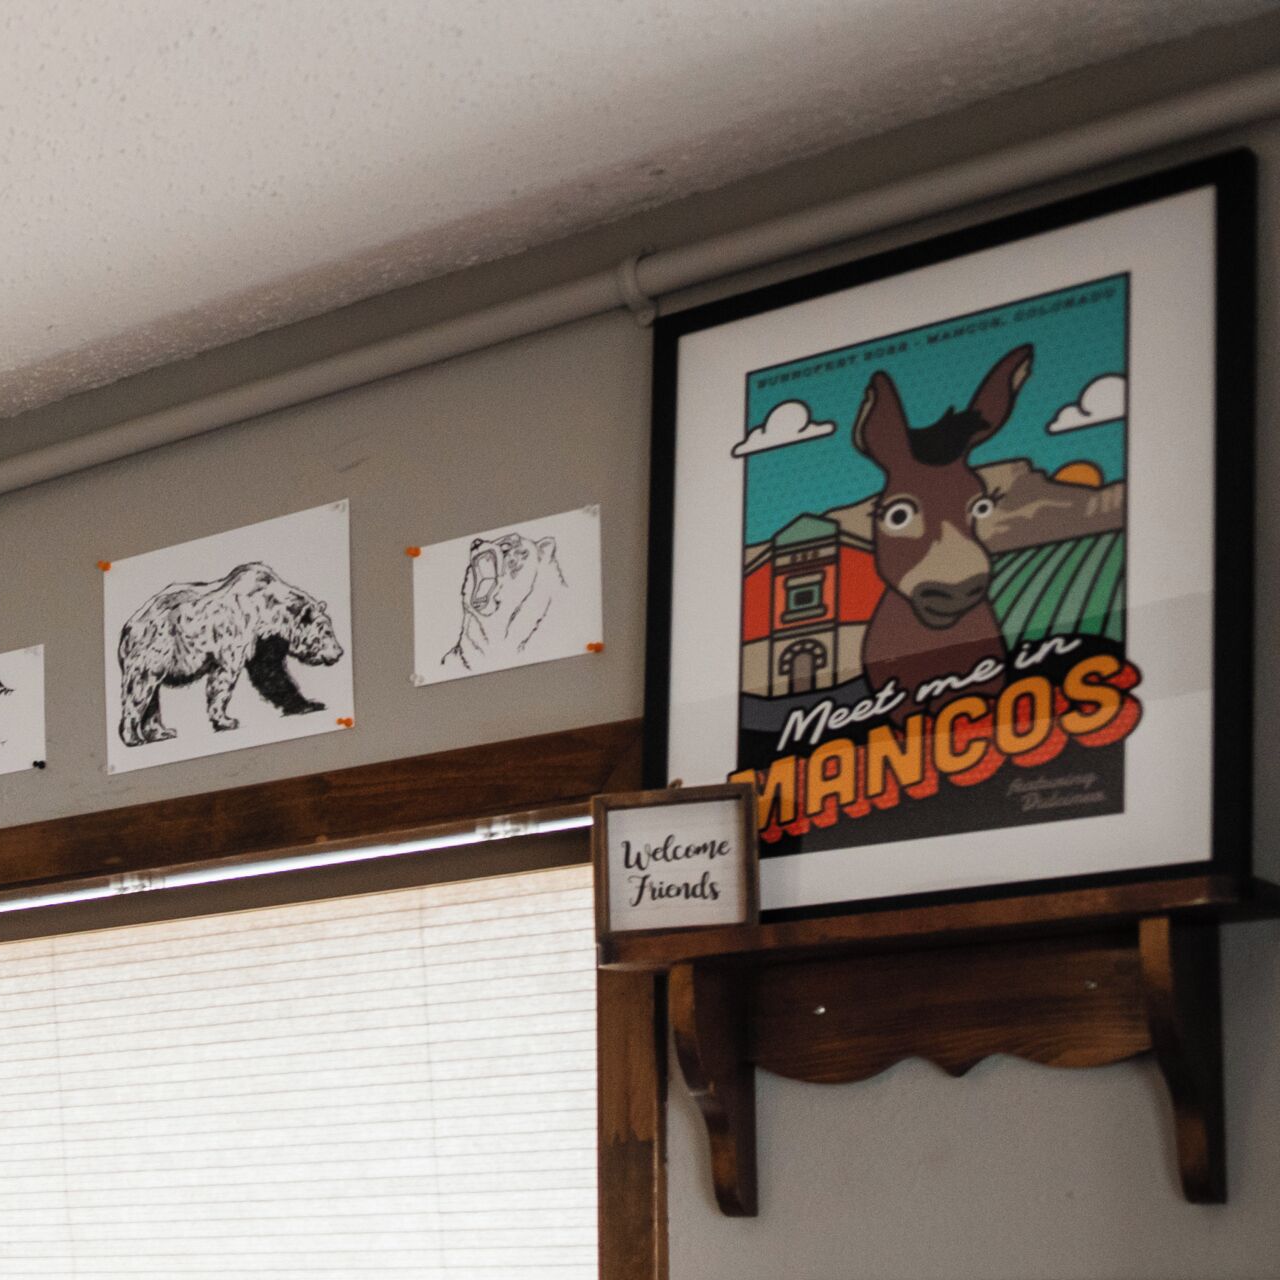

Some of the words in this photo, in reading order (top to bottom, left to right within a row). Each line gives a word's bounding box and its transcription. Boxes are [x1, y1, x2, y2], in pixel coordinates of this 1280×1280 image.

[777, 681, 907, 752] Meet
[915, 659, 1006, 702] me
[1014, 637, 1082, 669] in
[728, 654, 1143, 841] MANCOS
[621, 834, 731, 871] Welcome
[627, 870, 721, 907] Friends
